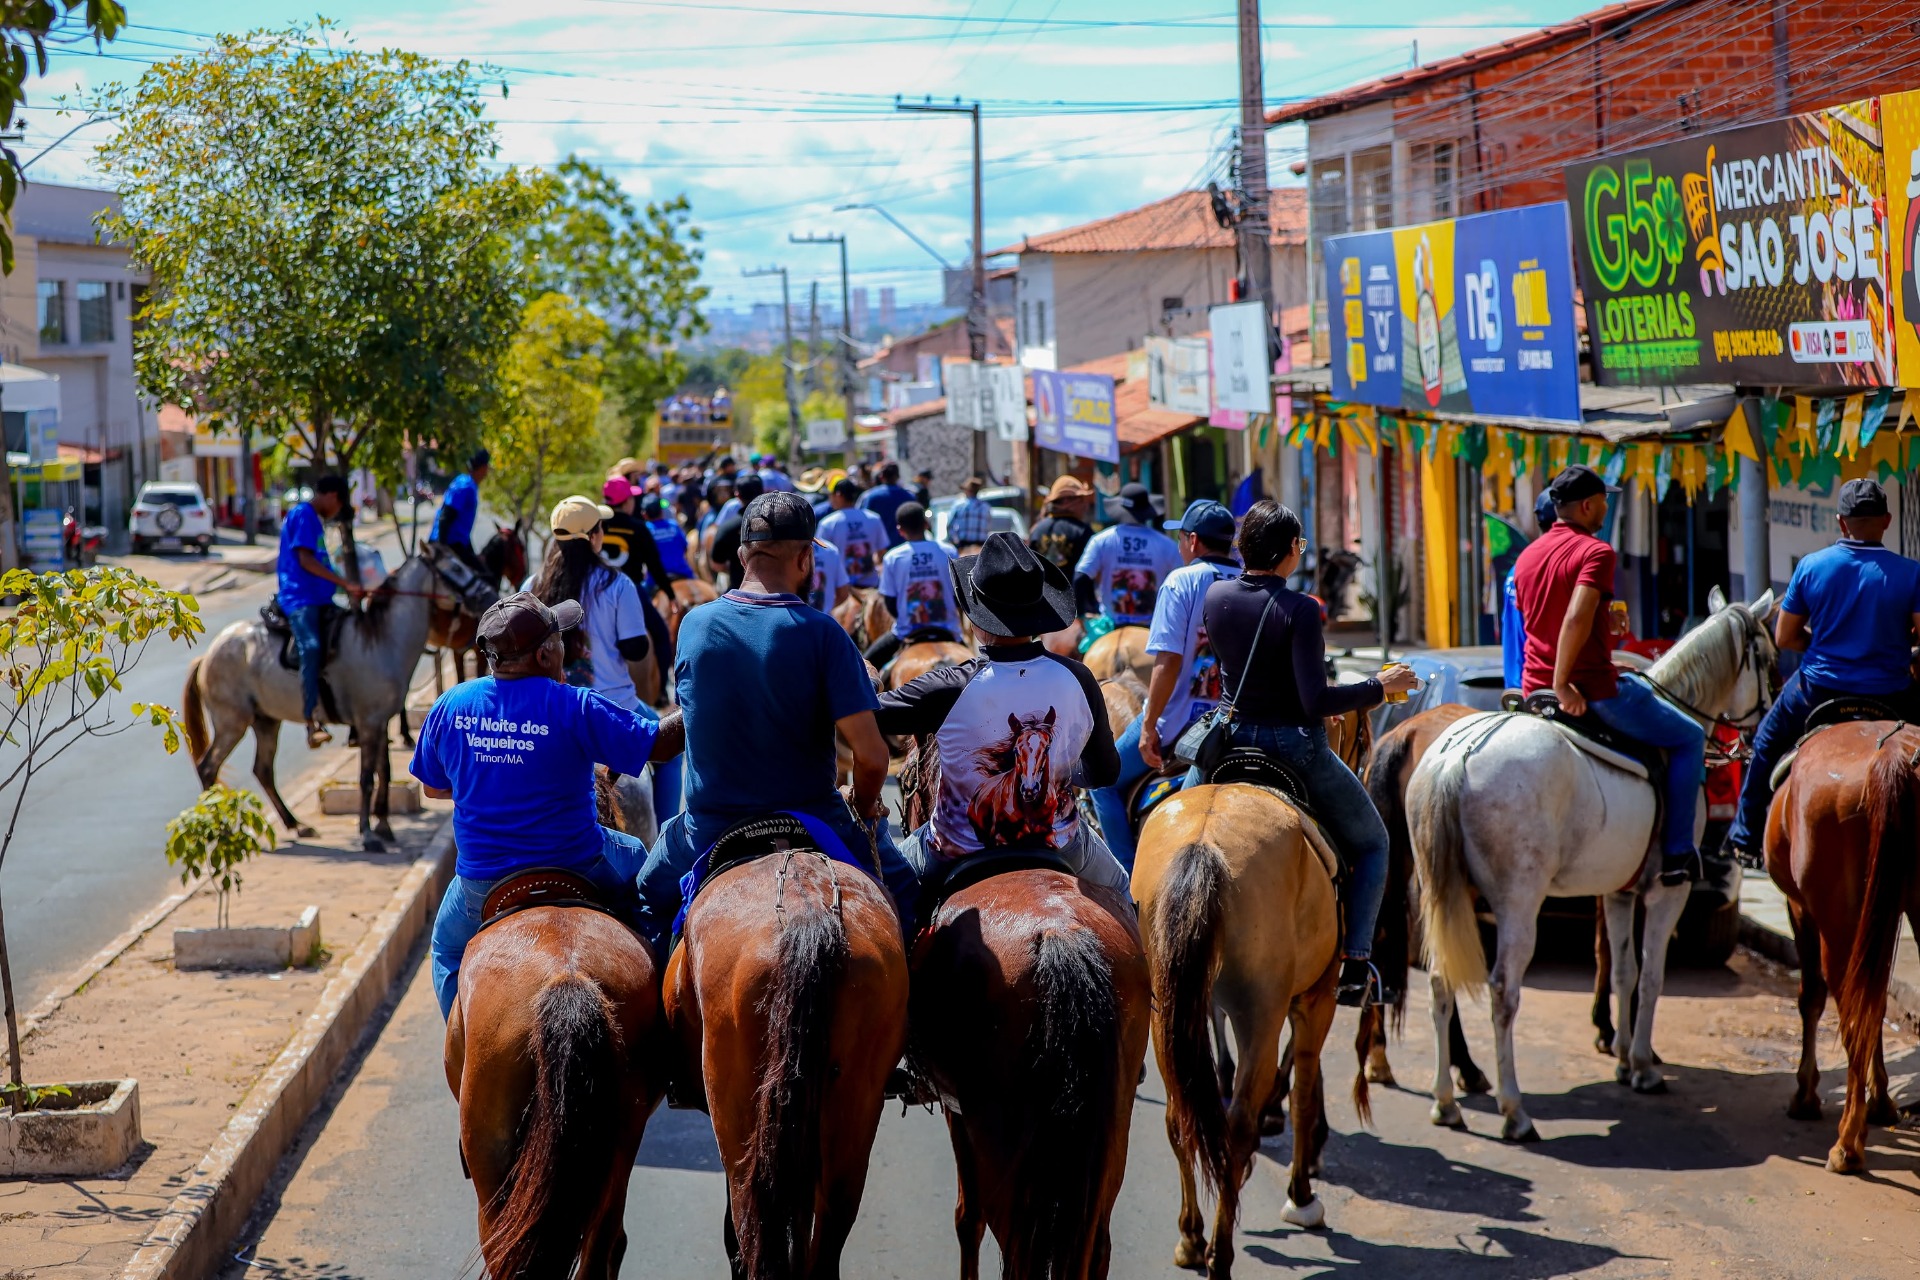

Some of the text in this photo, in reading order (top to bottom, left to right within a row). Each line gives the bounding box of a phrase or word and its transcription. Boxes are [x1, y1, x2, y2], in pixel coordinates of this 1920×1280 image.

[1711, 145, 1841, 212] MERCANTIL
[1584, 158, 1662, 292] G5
[1595, 291, 1696, 343] LOTERIAS
[1804, 332, 1823, 355] VISA
[454, 715, 549, 736] 53º Noite dos
[466, 732, 535, 752] Vaqueiros
[474, 752, 524, 764] Timon/MA
[744, 825, 810, 839] REGINALDO NET
